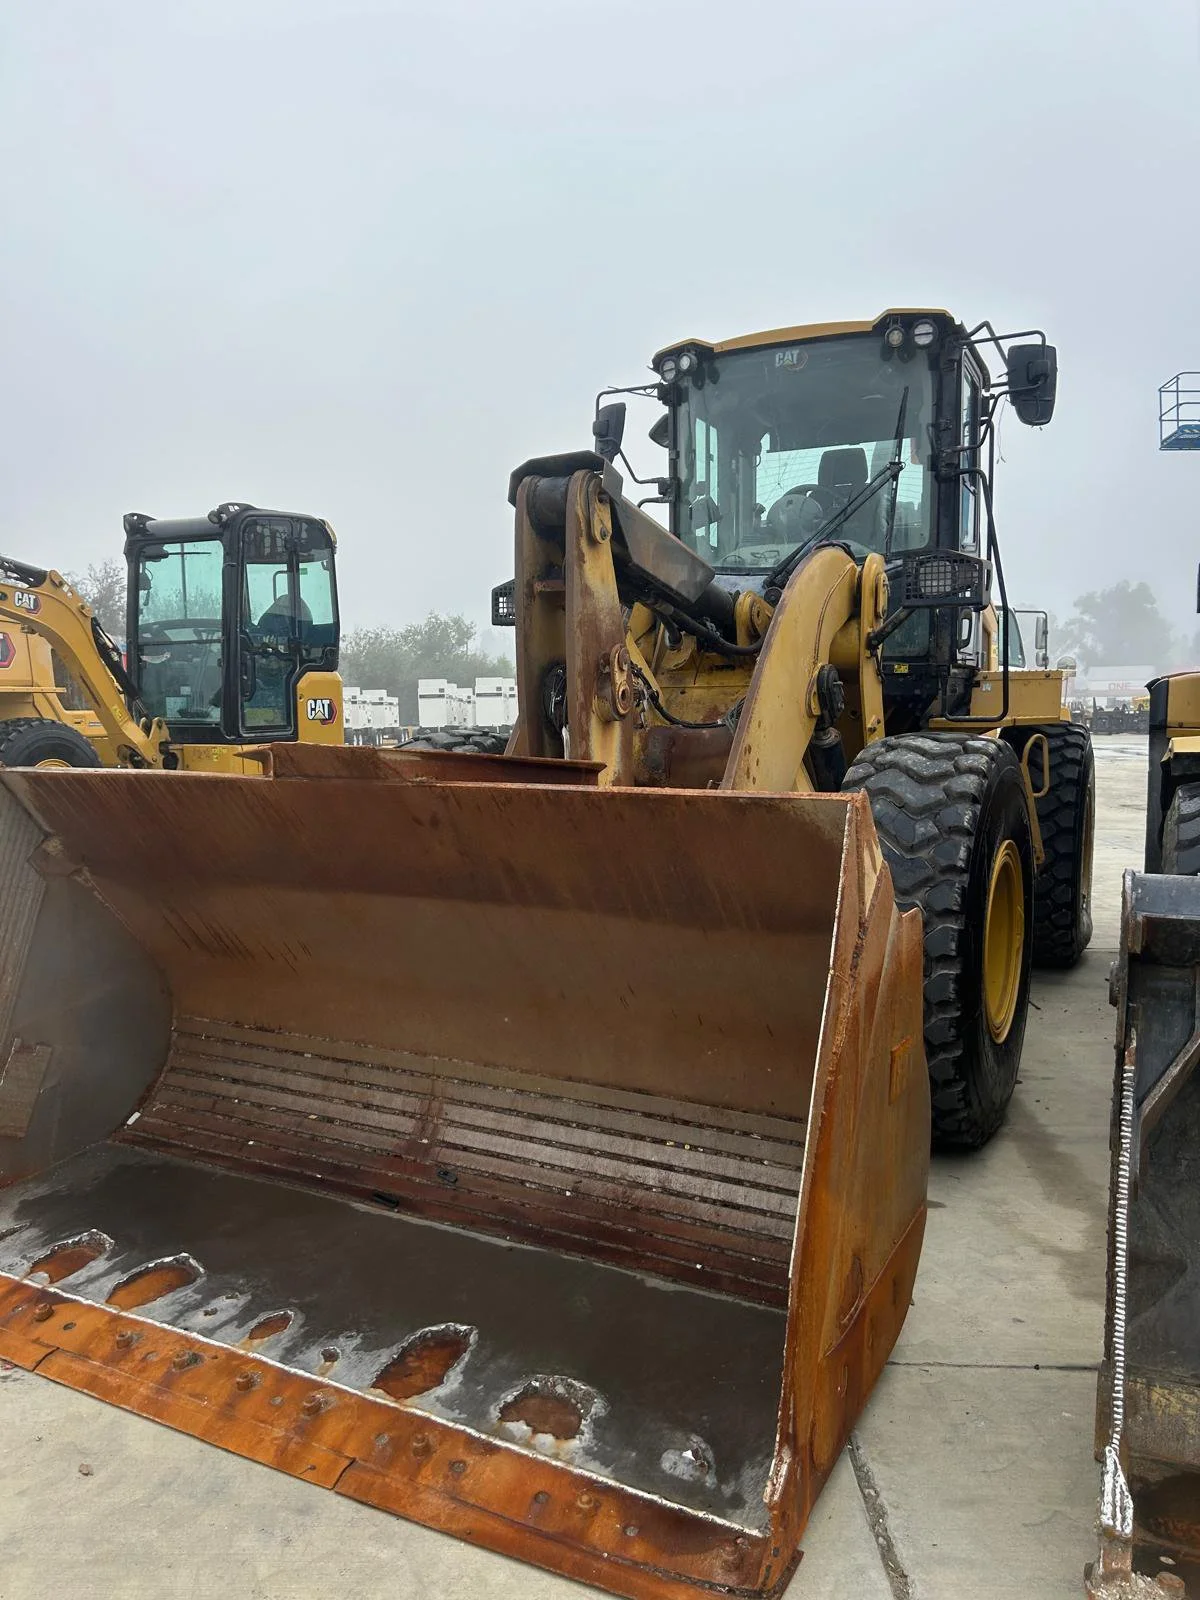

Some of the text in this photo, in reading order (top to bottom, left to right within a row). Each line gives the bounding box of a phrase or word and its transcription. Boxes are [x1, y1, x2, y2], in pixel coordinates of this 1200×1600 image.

[775, 350, 800, 367] CAT
[14, 591, 36, 609] CAT
[307, 699, 330, 720] CAT
